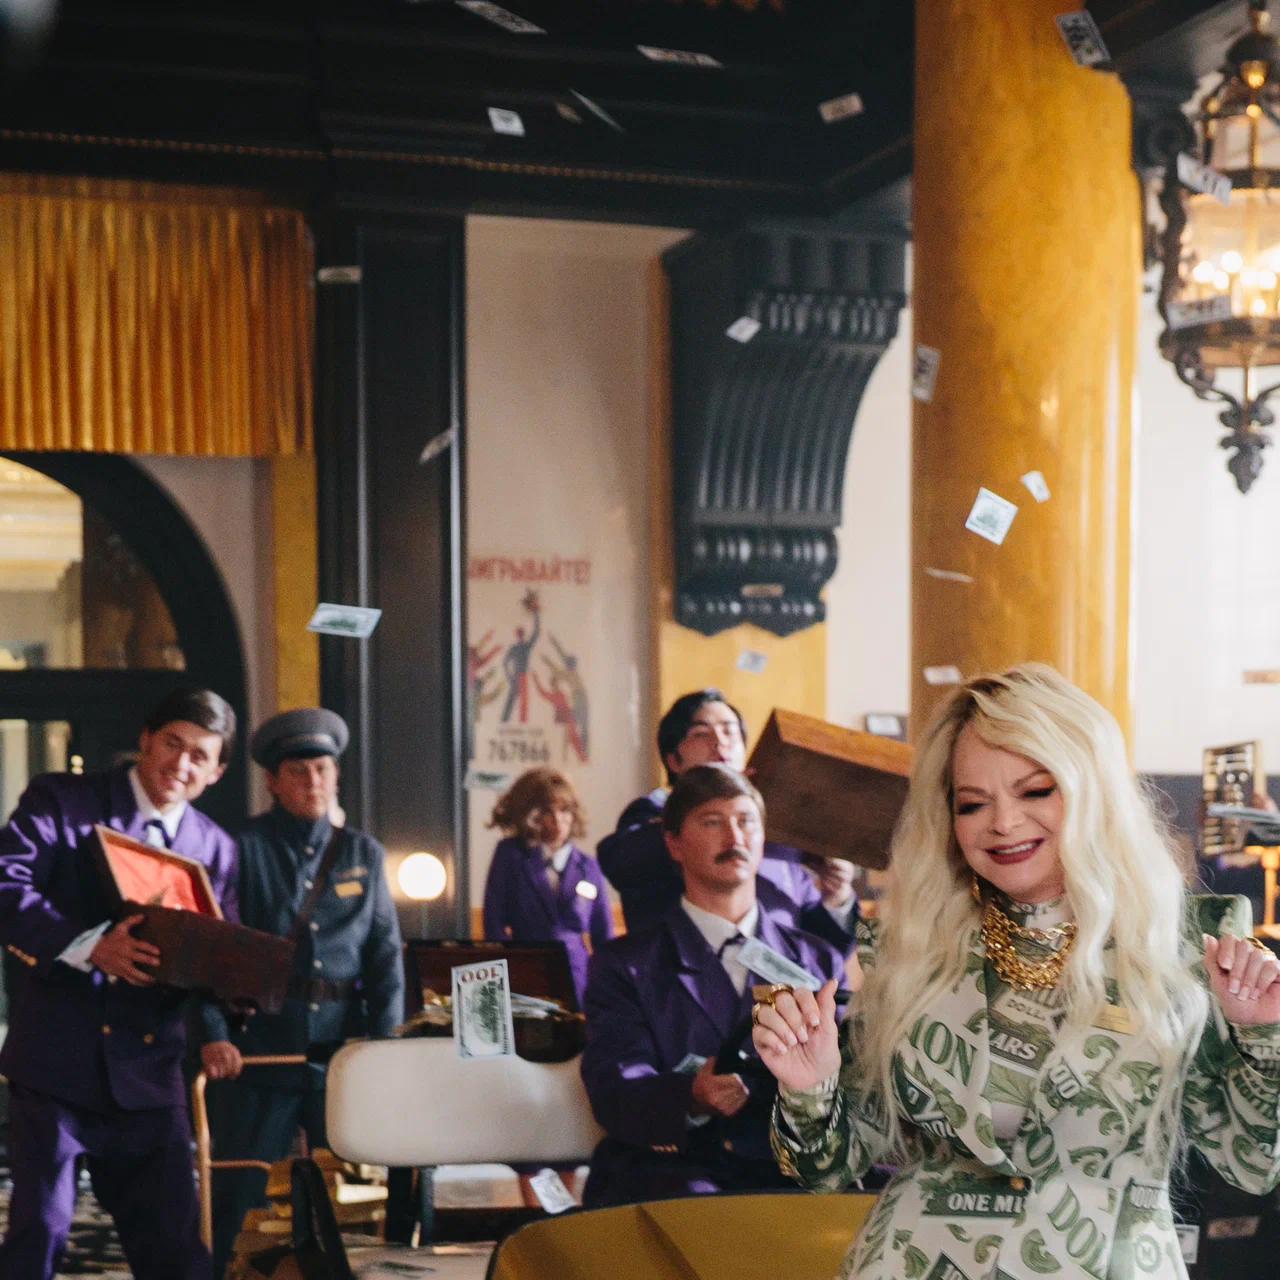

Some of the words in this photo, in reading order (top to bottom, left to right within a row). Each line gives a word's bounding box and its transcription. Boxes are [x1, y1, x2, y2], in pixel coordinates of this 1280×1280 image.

[460, 967, 501, 983] 100
[991, 1030, 1039, 1061] ARS
[947, 1194, 991, 1212] ONE
